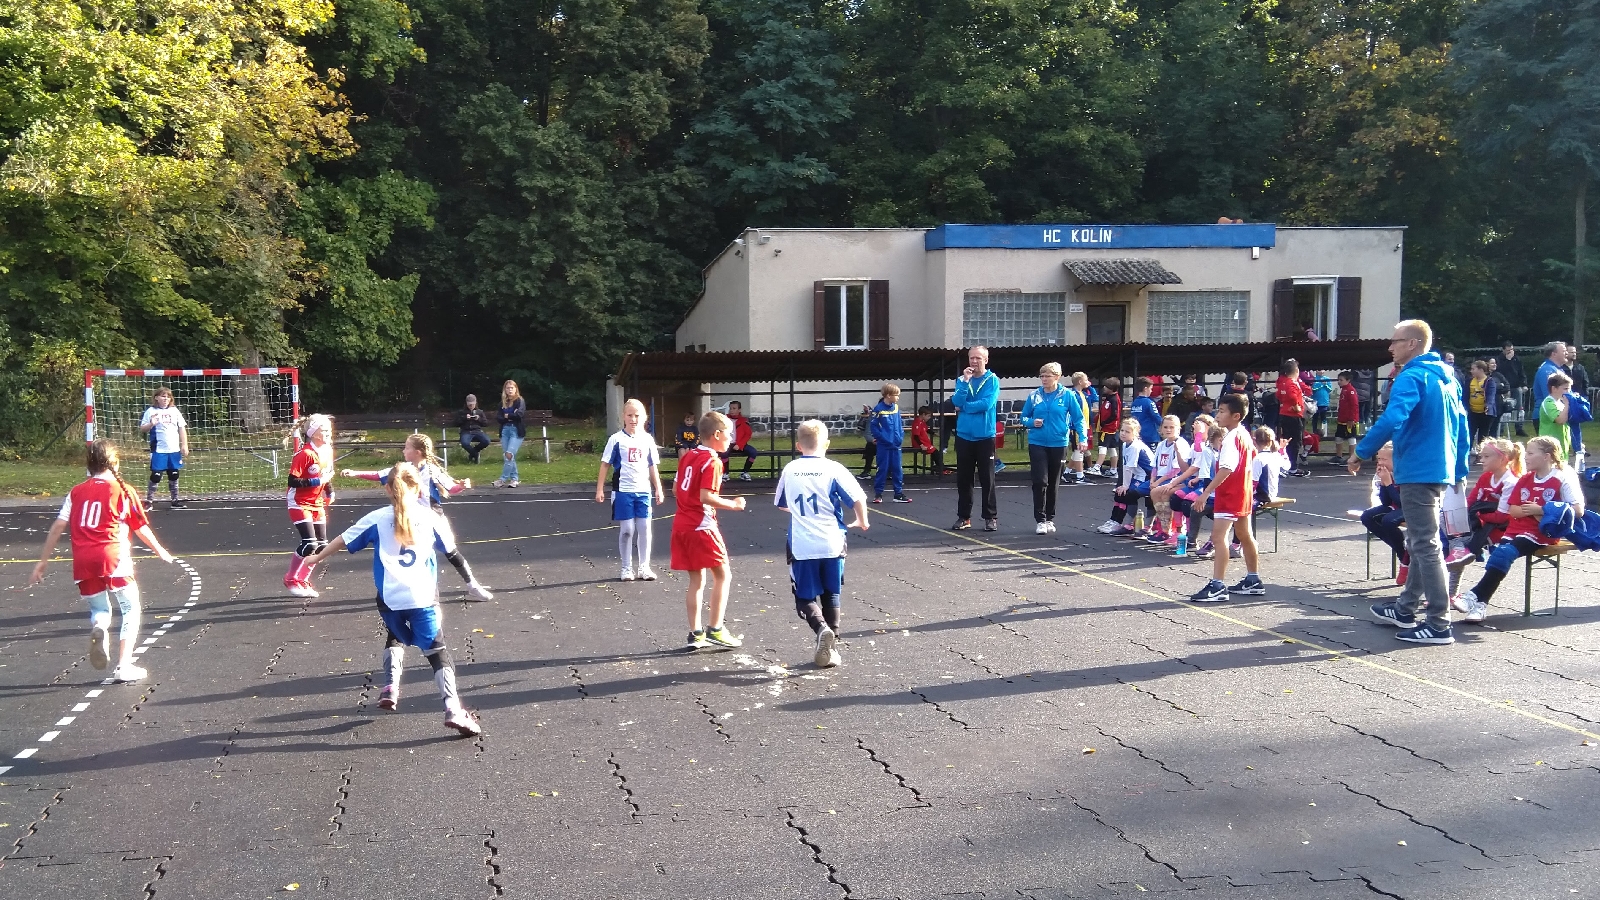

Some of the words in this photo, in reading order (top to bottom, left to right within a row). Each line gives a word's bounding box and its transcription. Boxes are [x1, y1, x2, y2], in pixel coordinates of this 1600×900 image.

[1043, 229, 1061, 243] HC
[1071, 227, 1112, 243] KOLÍN
[681, 466, 692, 491] 8
[80, 500, 101, 528] 10
[794, 492, 819, 516] 11
[398, 544, 417, 567] 5
